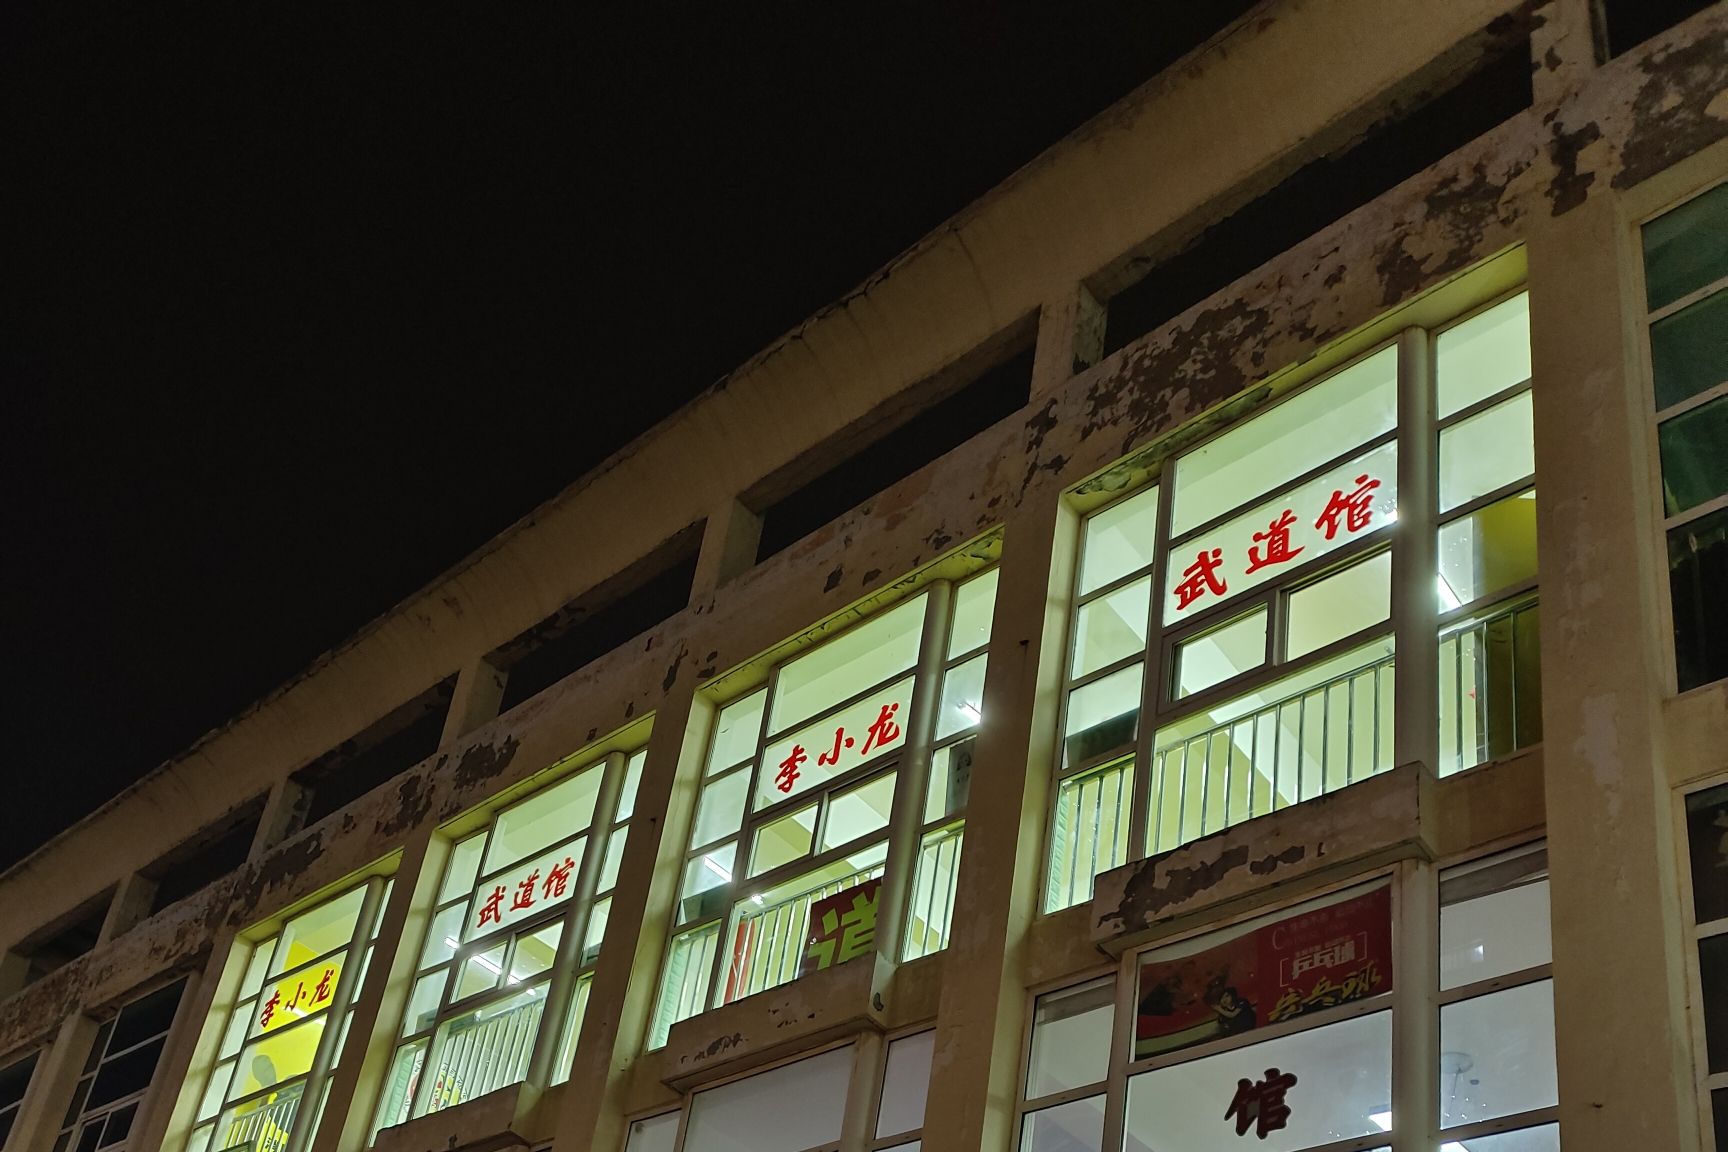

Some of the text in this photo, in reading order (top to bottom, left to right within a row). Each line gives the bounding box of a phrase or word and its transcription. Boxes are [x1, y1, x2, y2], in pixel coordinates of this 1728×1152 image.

[1173, 475, 1382, 612] 武道馆
[774, 702, 901, 794] 李小龙
[476, 857, 576, 930] 武道馆
[259, 968, 335, 1029] 李小龙
[1225, 1067, 1297, 1139] 馆
